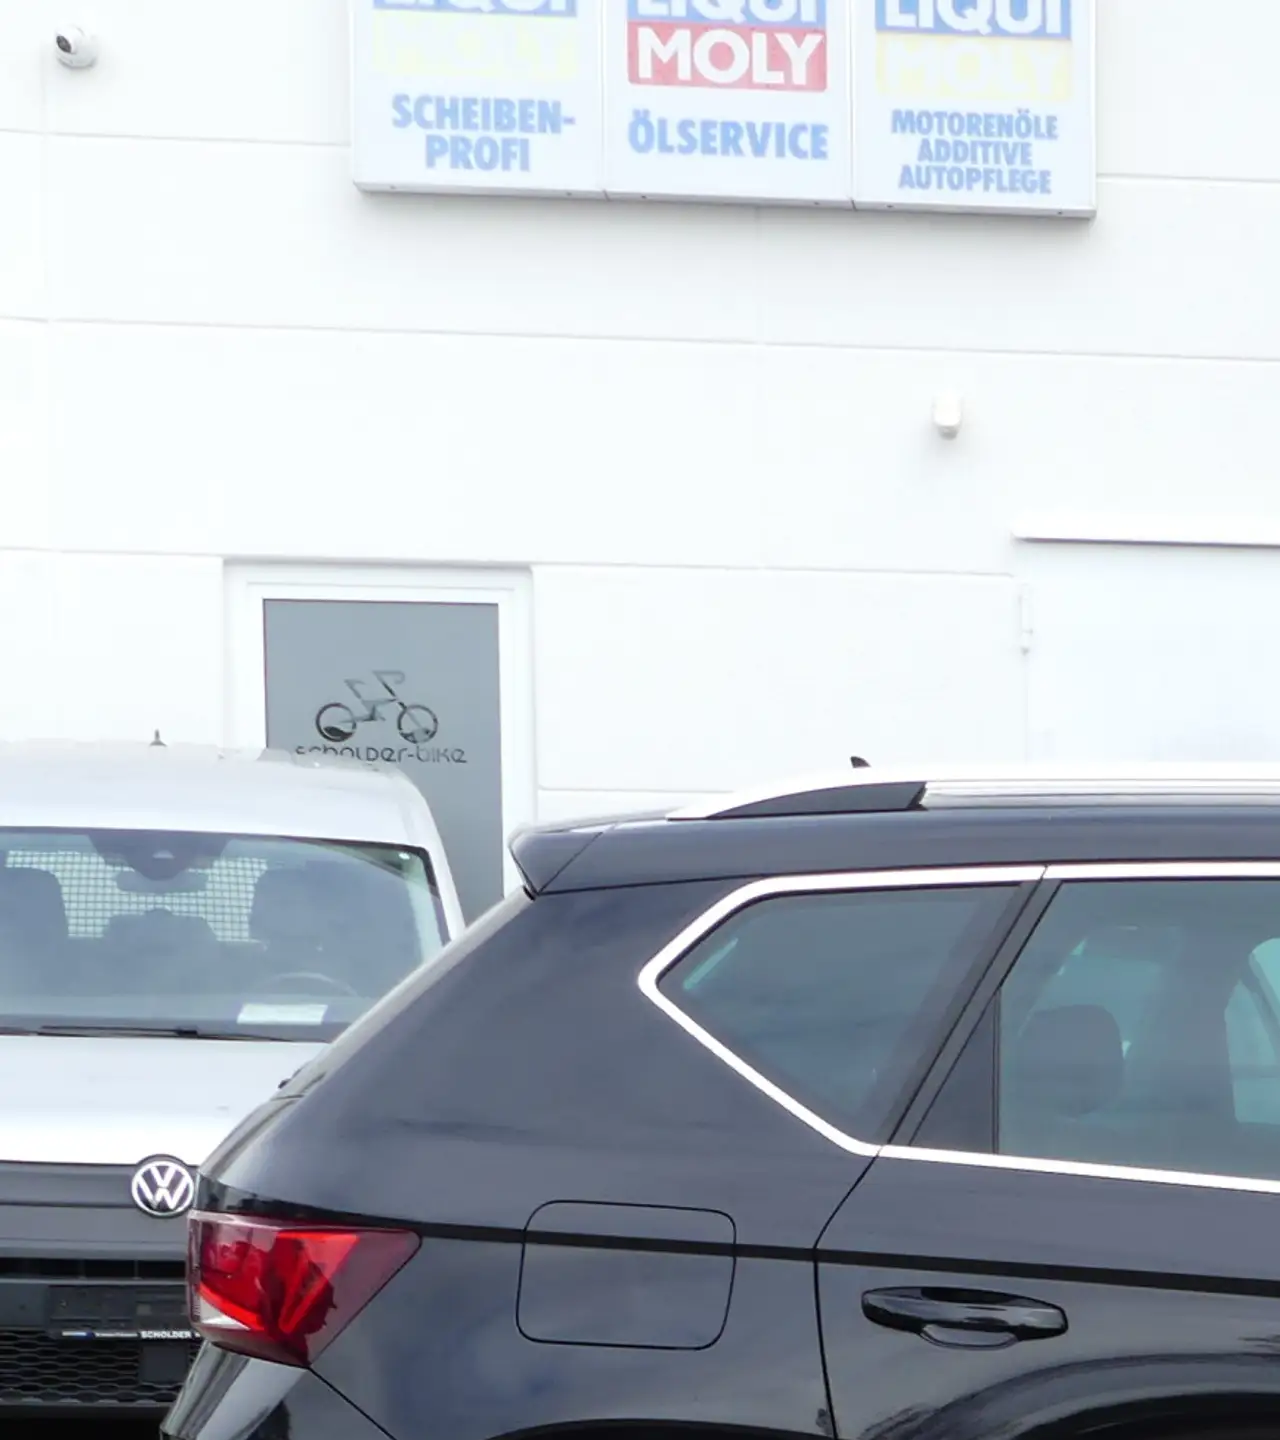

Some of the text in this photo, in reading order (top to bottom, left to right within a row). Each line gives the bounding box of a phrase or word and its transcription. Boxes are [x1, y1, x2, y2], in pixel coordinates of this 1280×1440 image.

[637, 26, 825, 85] MOLY
[391, 93, 576, 134] SCHEIBEN-
[891, 108, 1059, 141] MOTORENÖLE
[425, 134, 530, 172] PROFI
[627, 108, 829, 160] ÖLSERVICE
[917, 138, 1033, 166] ADDITIVE
[898, 165, 1053, 195] AUTOPFLEGE
